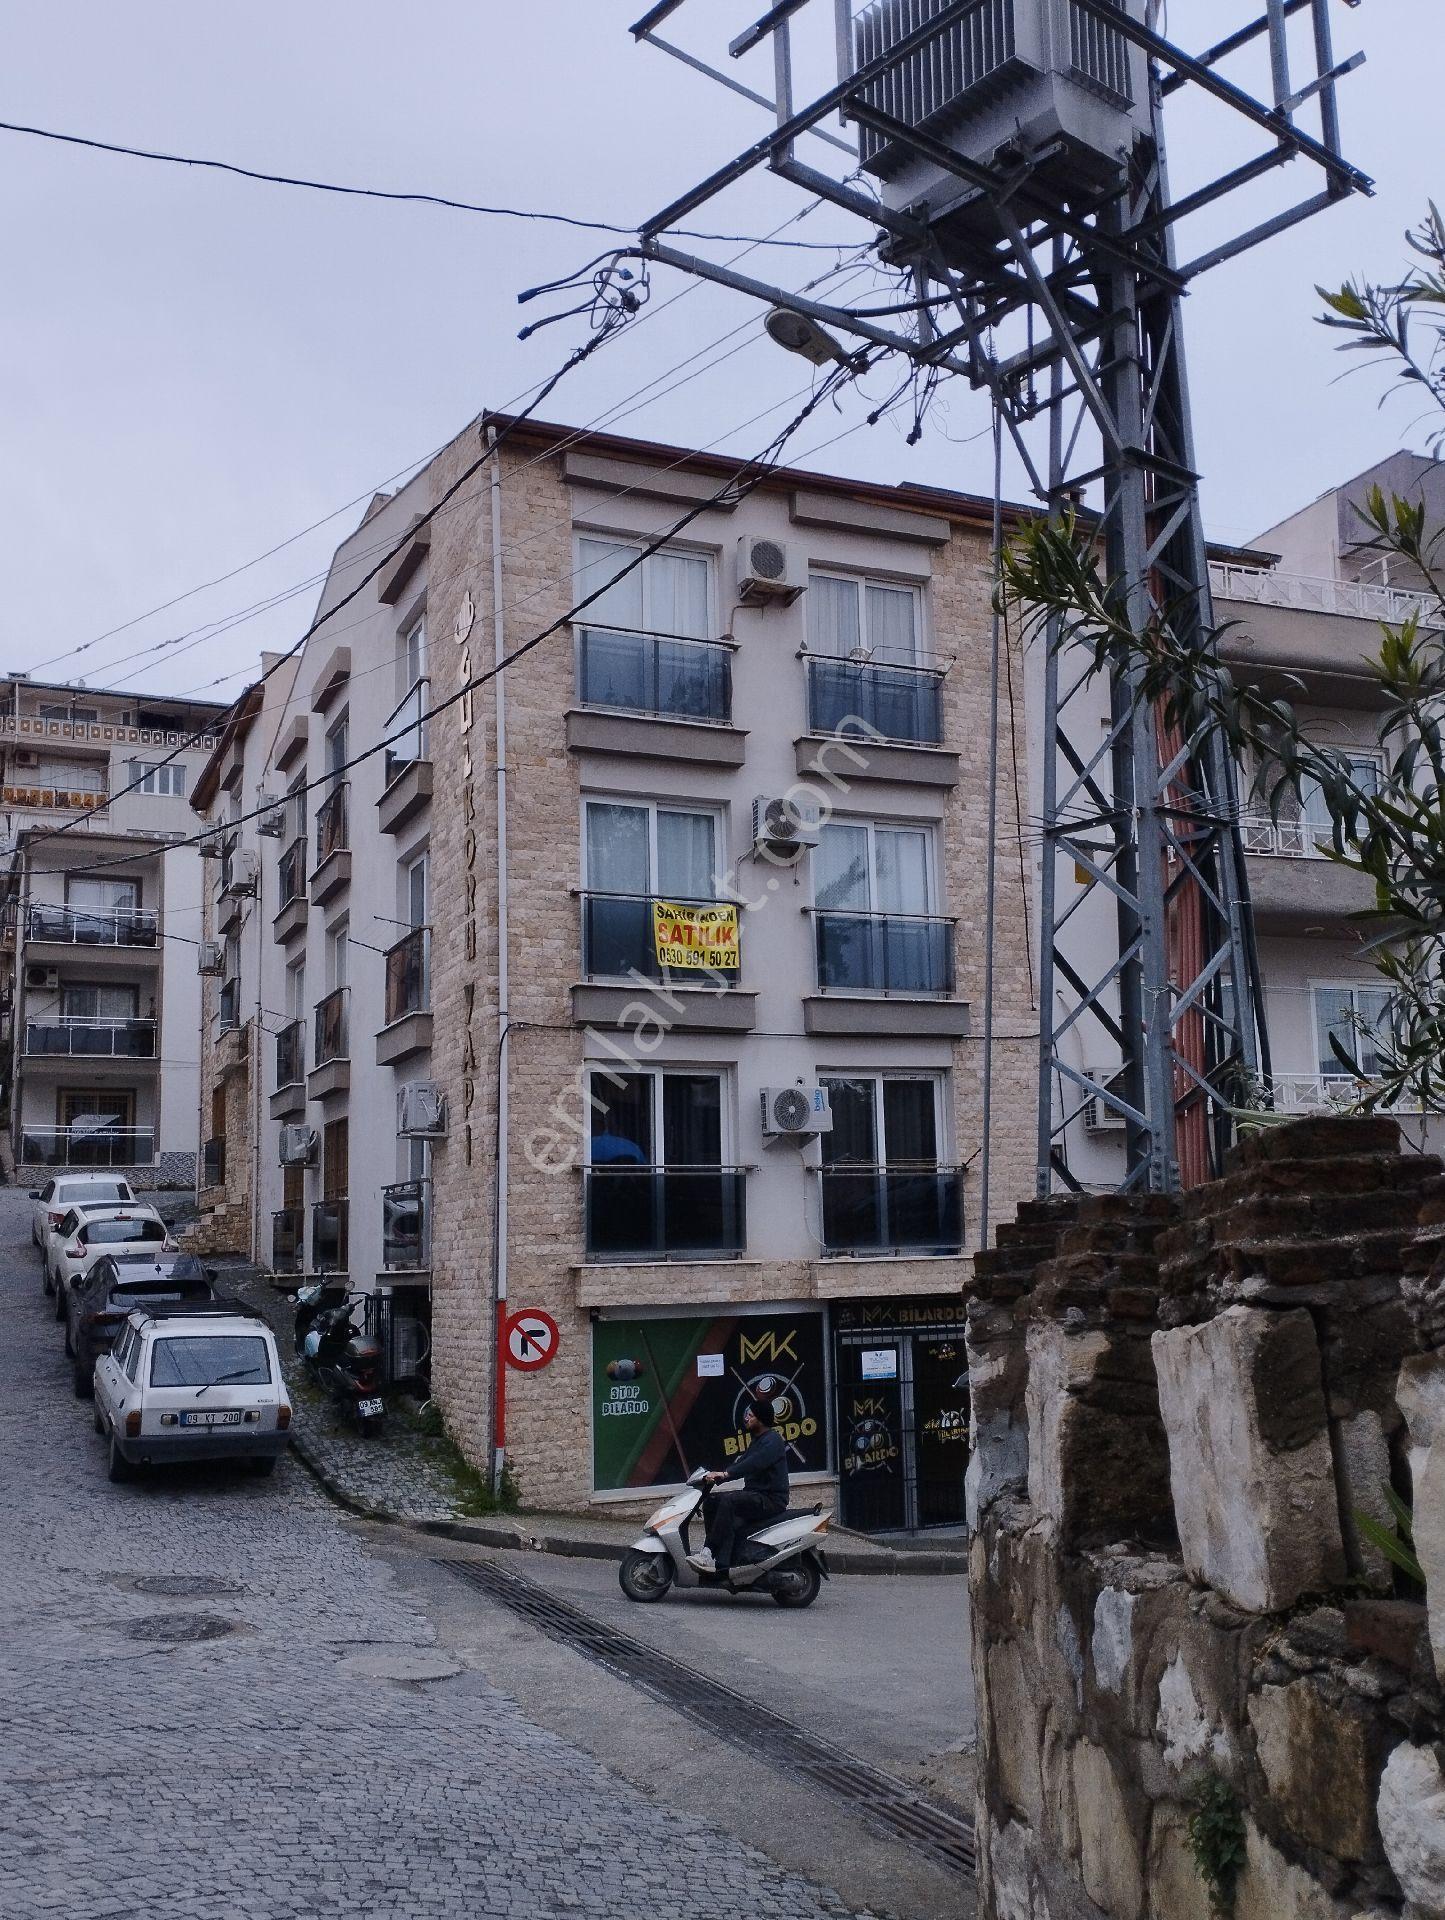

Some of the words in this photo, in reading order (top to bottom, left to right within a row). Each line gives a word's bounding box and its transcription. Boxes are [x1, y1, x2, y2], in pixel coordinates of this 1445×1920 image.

[657, 922, 736, 946] SATILIK
[659, 947, 683, 965] 0530
[686, 950, 705, 966] 591
[709, 951, 721, 967] 50
[724, 951, 737, 967] 27
[740, 1329, 798, 1365] MK
[187, 1414, 198, 1424] 09
[222, 1413, 239, 1423] 200
